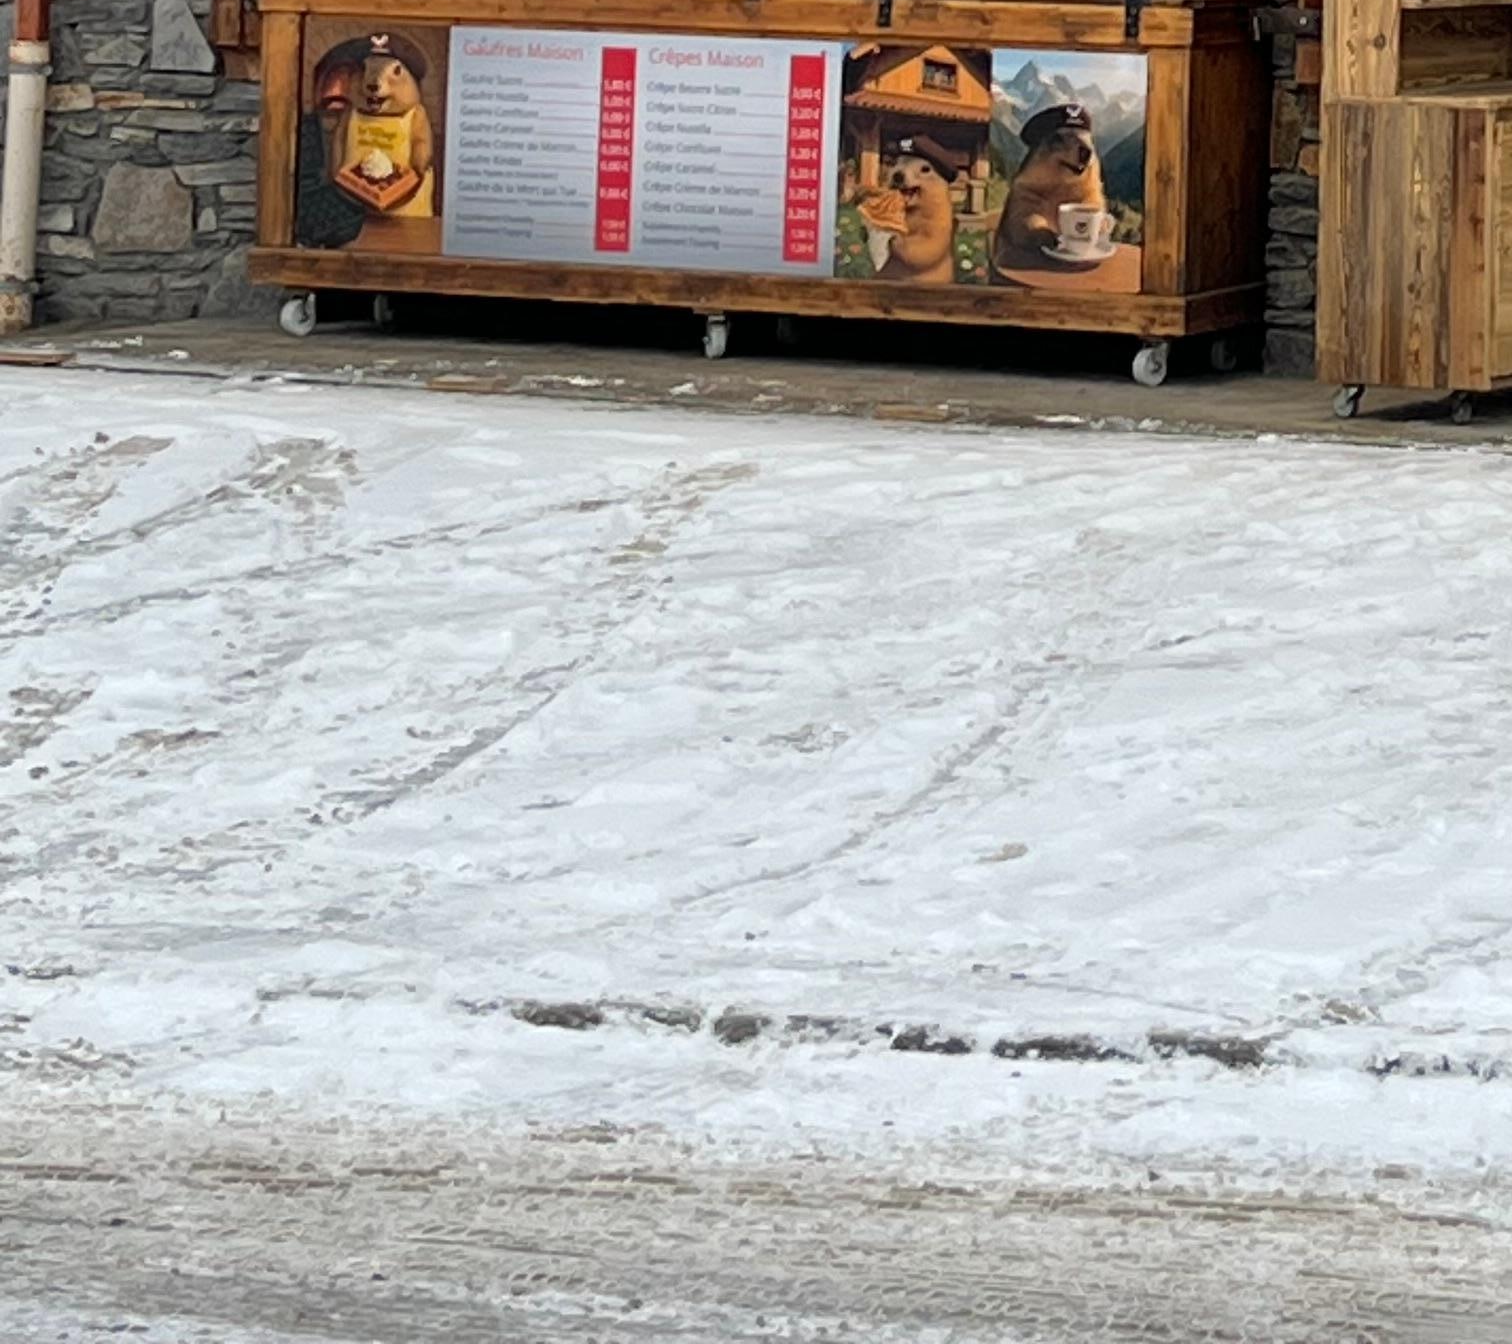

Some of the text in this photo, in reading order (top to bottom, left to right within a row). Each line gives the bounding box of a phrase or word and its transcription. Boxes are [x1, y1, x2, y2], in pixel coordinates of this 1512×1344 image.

[527, 43, 584, 60] Maison
[649, 48, 764, 69] Crêpes Maison
